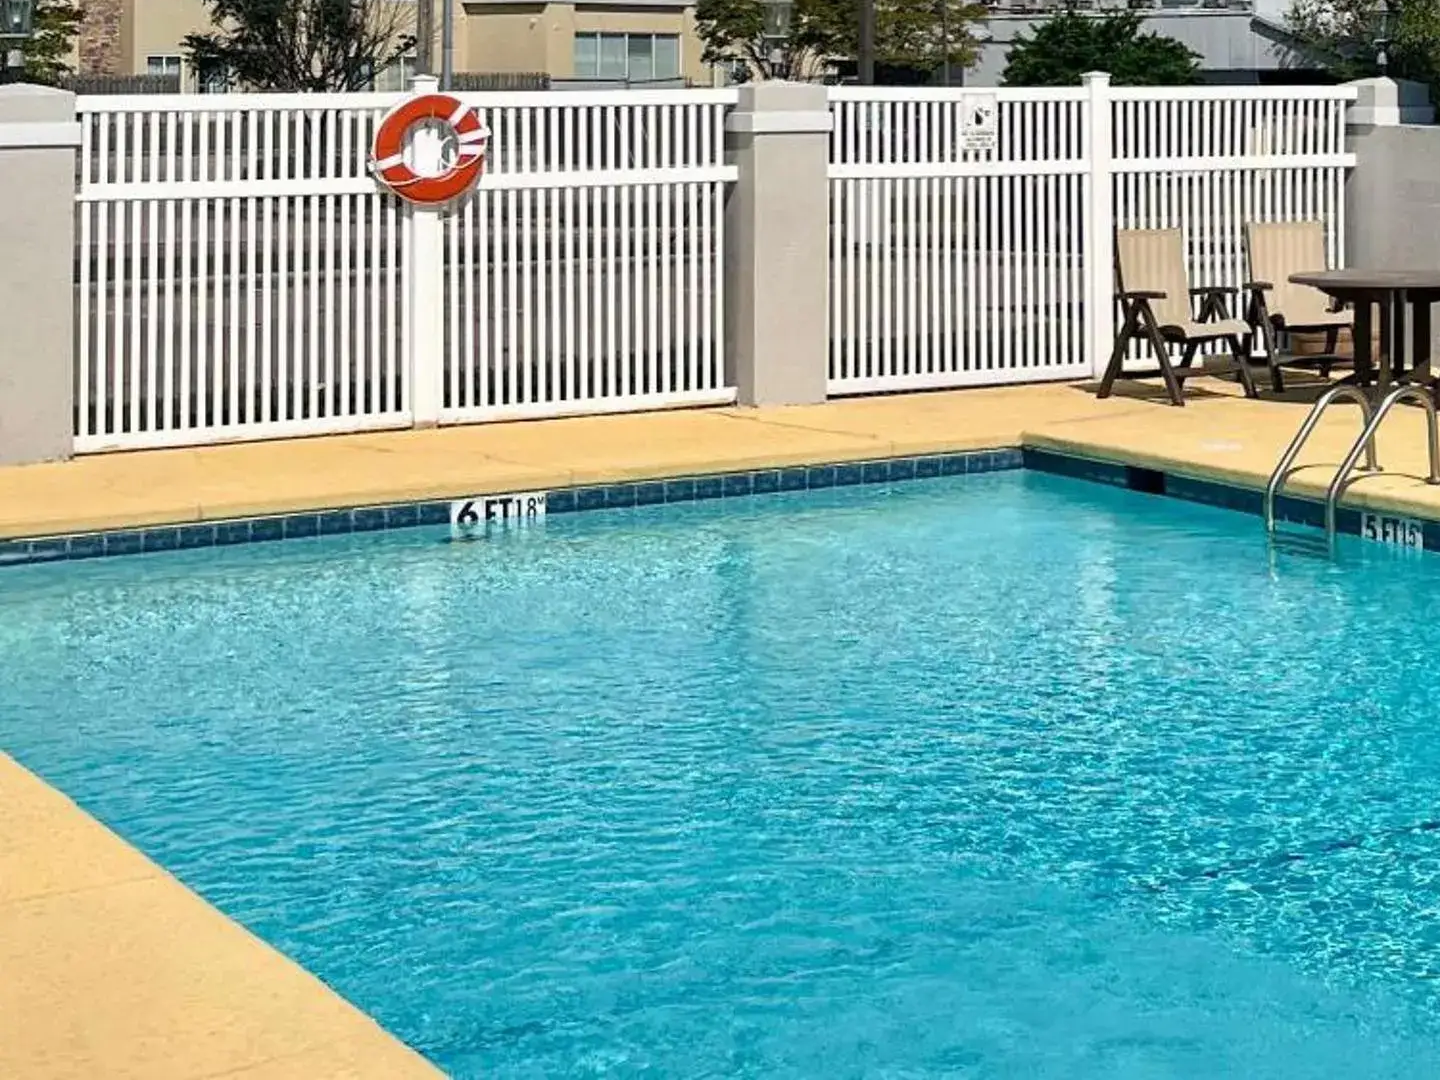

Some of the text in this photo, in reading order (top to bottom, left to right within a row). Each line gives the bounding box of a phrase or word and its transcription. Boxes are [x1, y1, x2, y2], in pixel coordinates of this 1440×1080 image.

[457, 501, 479, 523] 6
[485, 498, 514, 520] FT
[1366, 515, 1377, 540] 5
